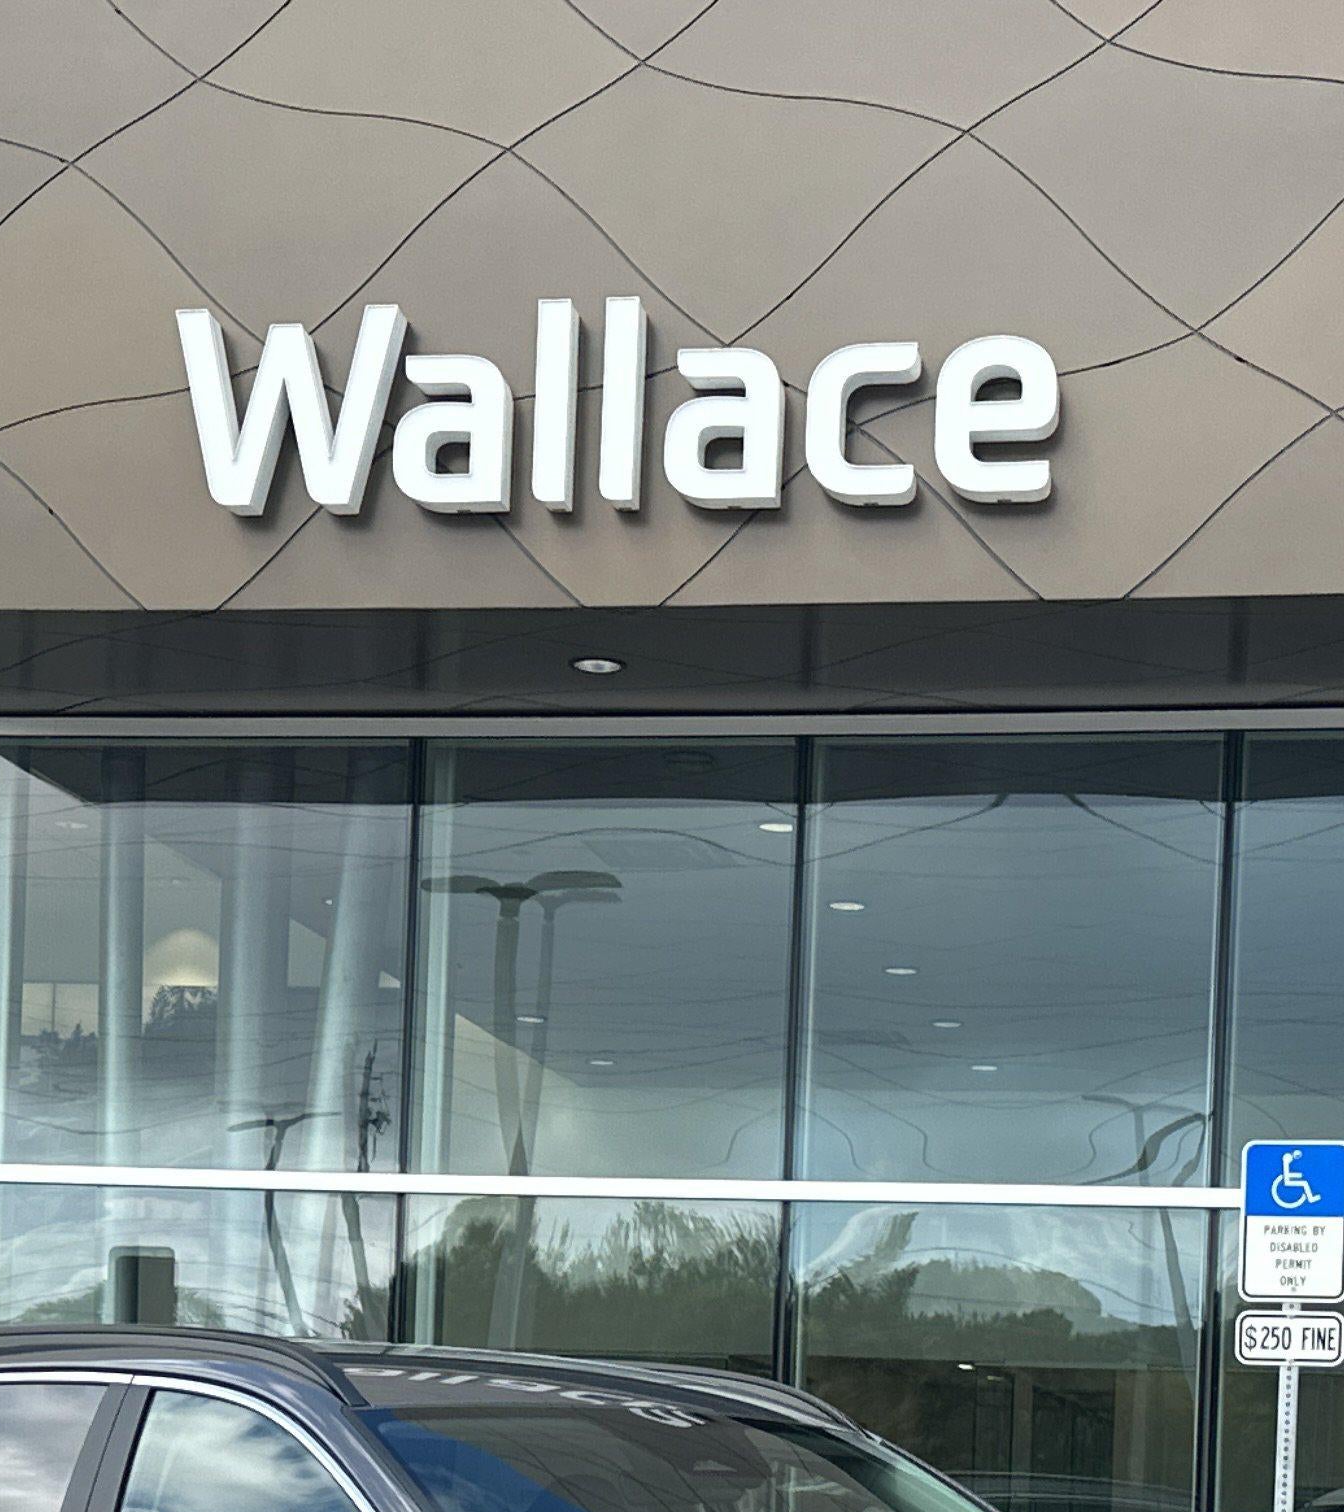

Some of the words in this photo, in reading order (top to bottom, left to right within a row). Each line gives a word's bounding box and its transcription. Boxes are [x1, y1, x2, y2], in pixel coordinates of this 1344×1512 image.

[175, 295, 1060, 517] Wallace
[1263, 1225, 1308, 1236] PARKING
[1312, 1225, 1326, 1236] BY
[1269, 1242, 1318, 1253] DISABLED
[1275, 1258, 1312, 1270] PERMIT
[1279, 1275, 1307, 1286] ONLY
[1244, 1323, 1293, 1352] $250
[1301, 1326, 1337, 1352] FINE
